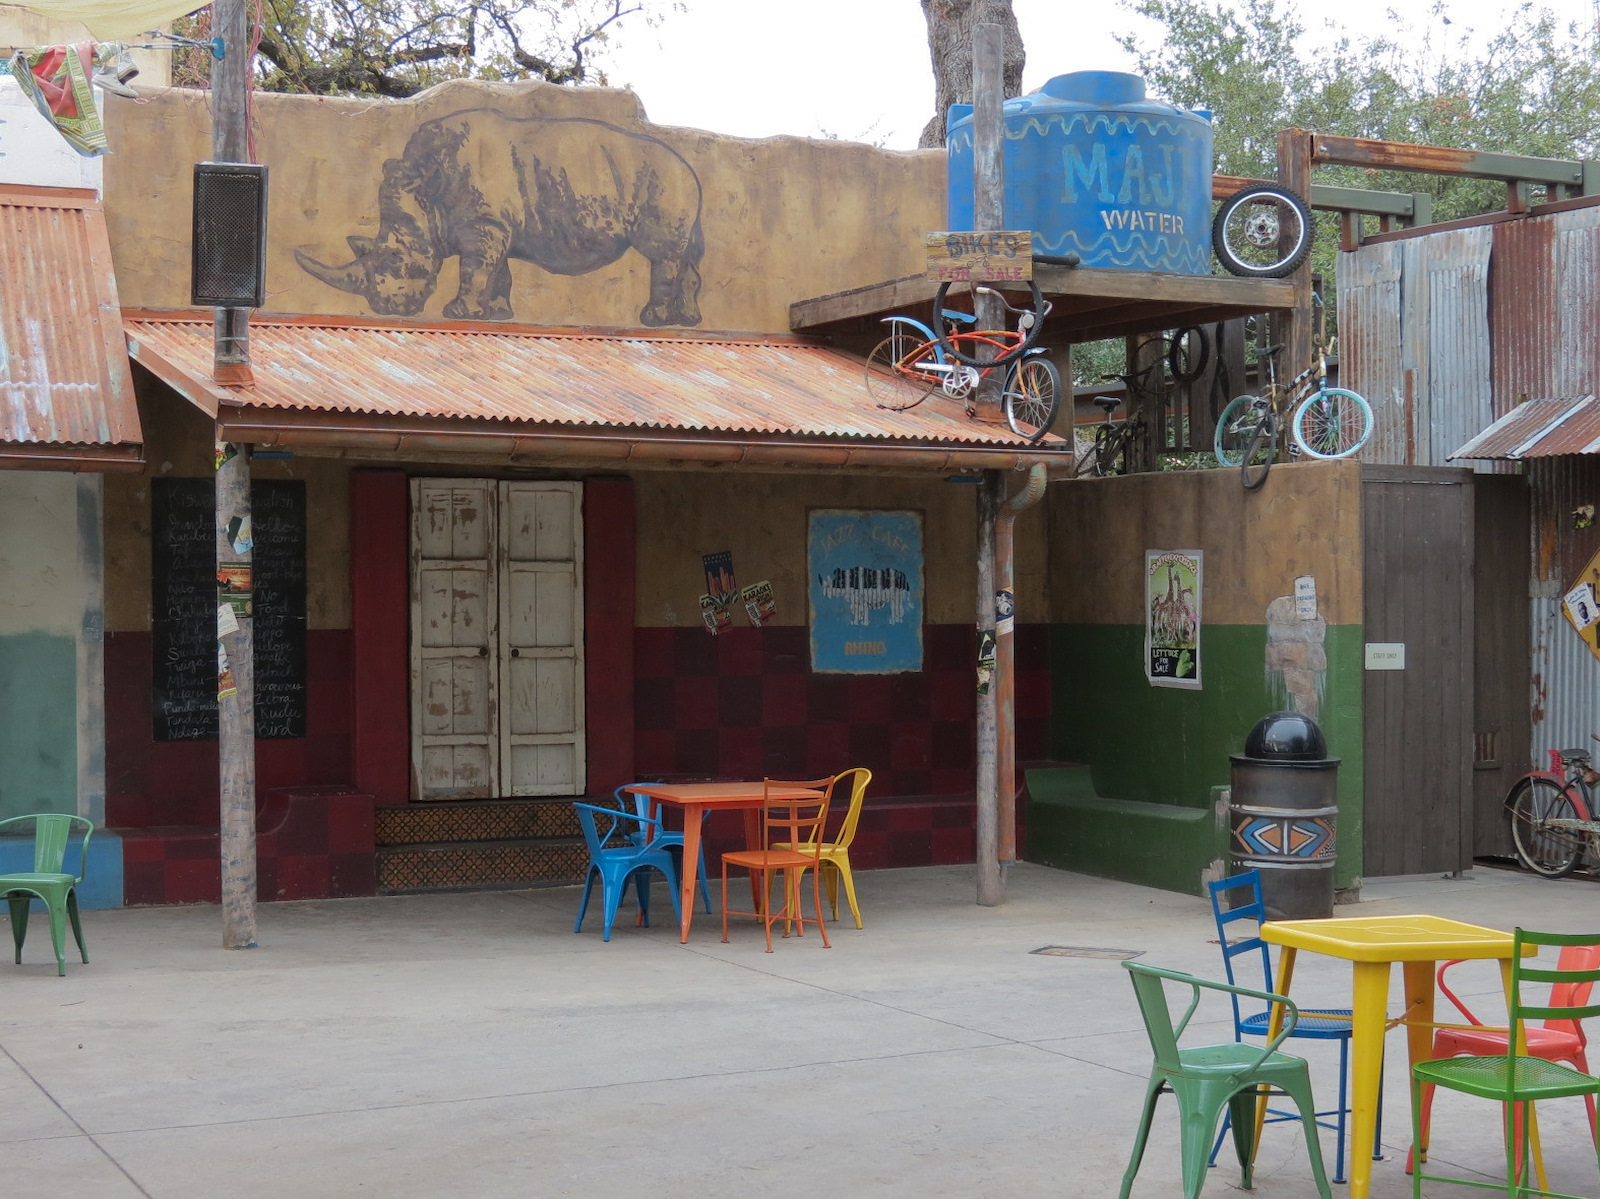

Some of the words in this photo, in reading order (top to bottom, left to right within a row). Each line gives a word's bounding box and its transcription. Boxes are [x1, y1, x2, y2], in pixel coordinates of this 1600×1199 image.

[1060, 143, 1192, 214] MAJI
[1099, 209, 1185, 235] WATER
[945, 233, 1019, 258] BIKES
[937, 267, 970, 281] FOR
[986, 267, 1024, 280] SALE
[819, 524, 857, 554] JAZZ
[742, 583, 771, 602] KARAOKE
[844, 642, 886, 655] RHINO
[1152, 649, 1179, 659] LETTUCE
[1153, 662, 1168, 674] SALE
[257, 717, 297, 737] Bird
